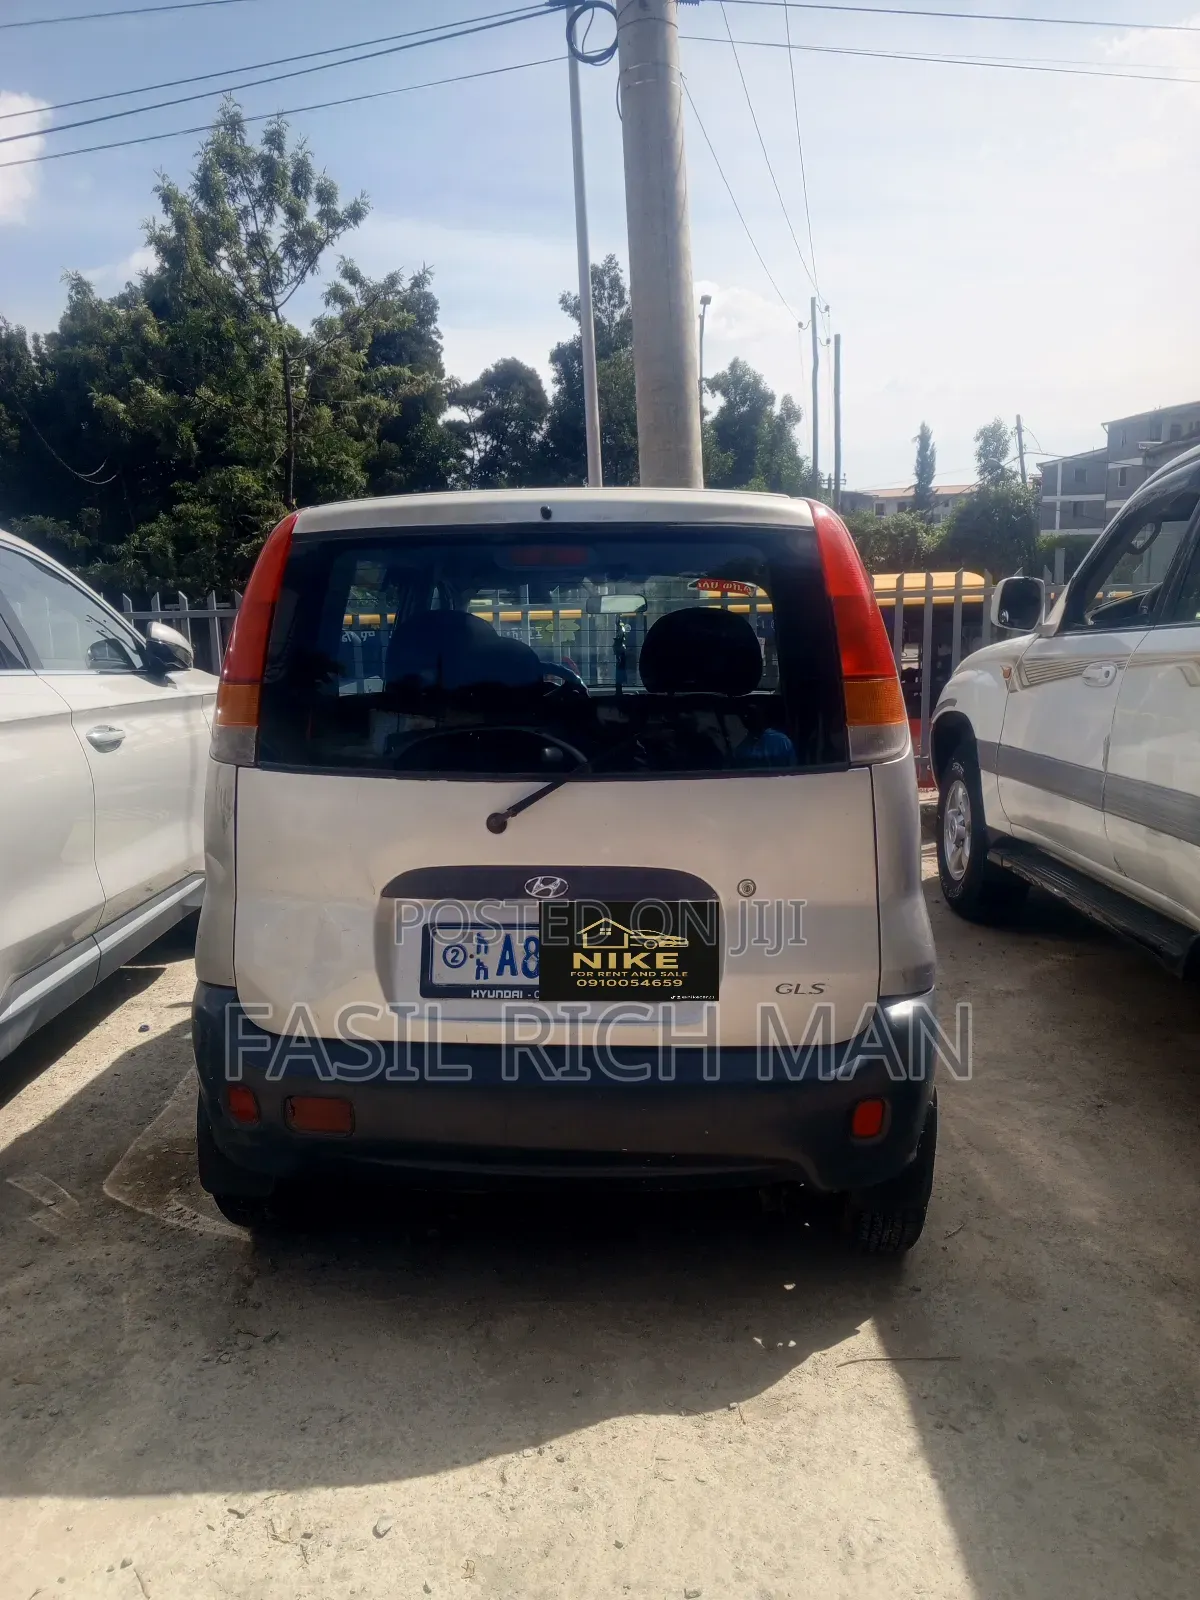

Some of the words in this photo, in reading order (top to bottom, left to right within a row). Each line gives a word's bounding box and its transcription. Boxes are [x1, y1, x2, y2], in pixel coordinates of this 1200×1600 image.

[496, 933, 540, 979] A8
[471, 989, 523, 999] HYUNDAI
[775, 983, 826, 995] GLS
